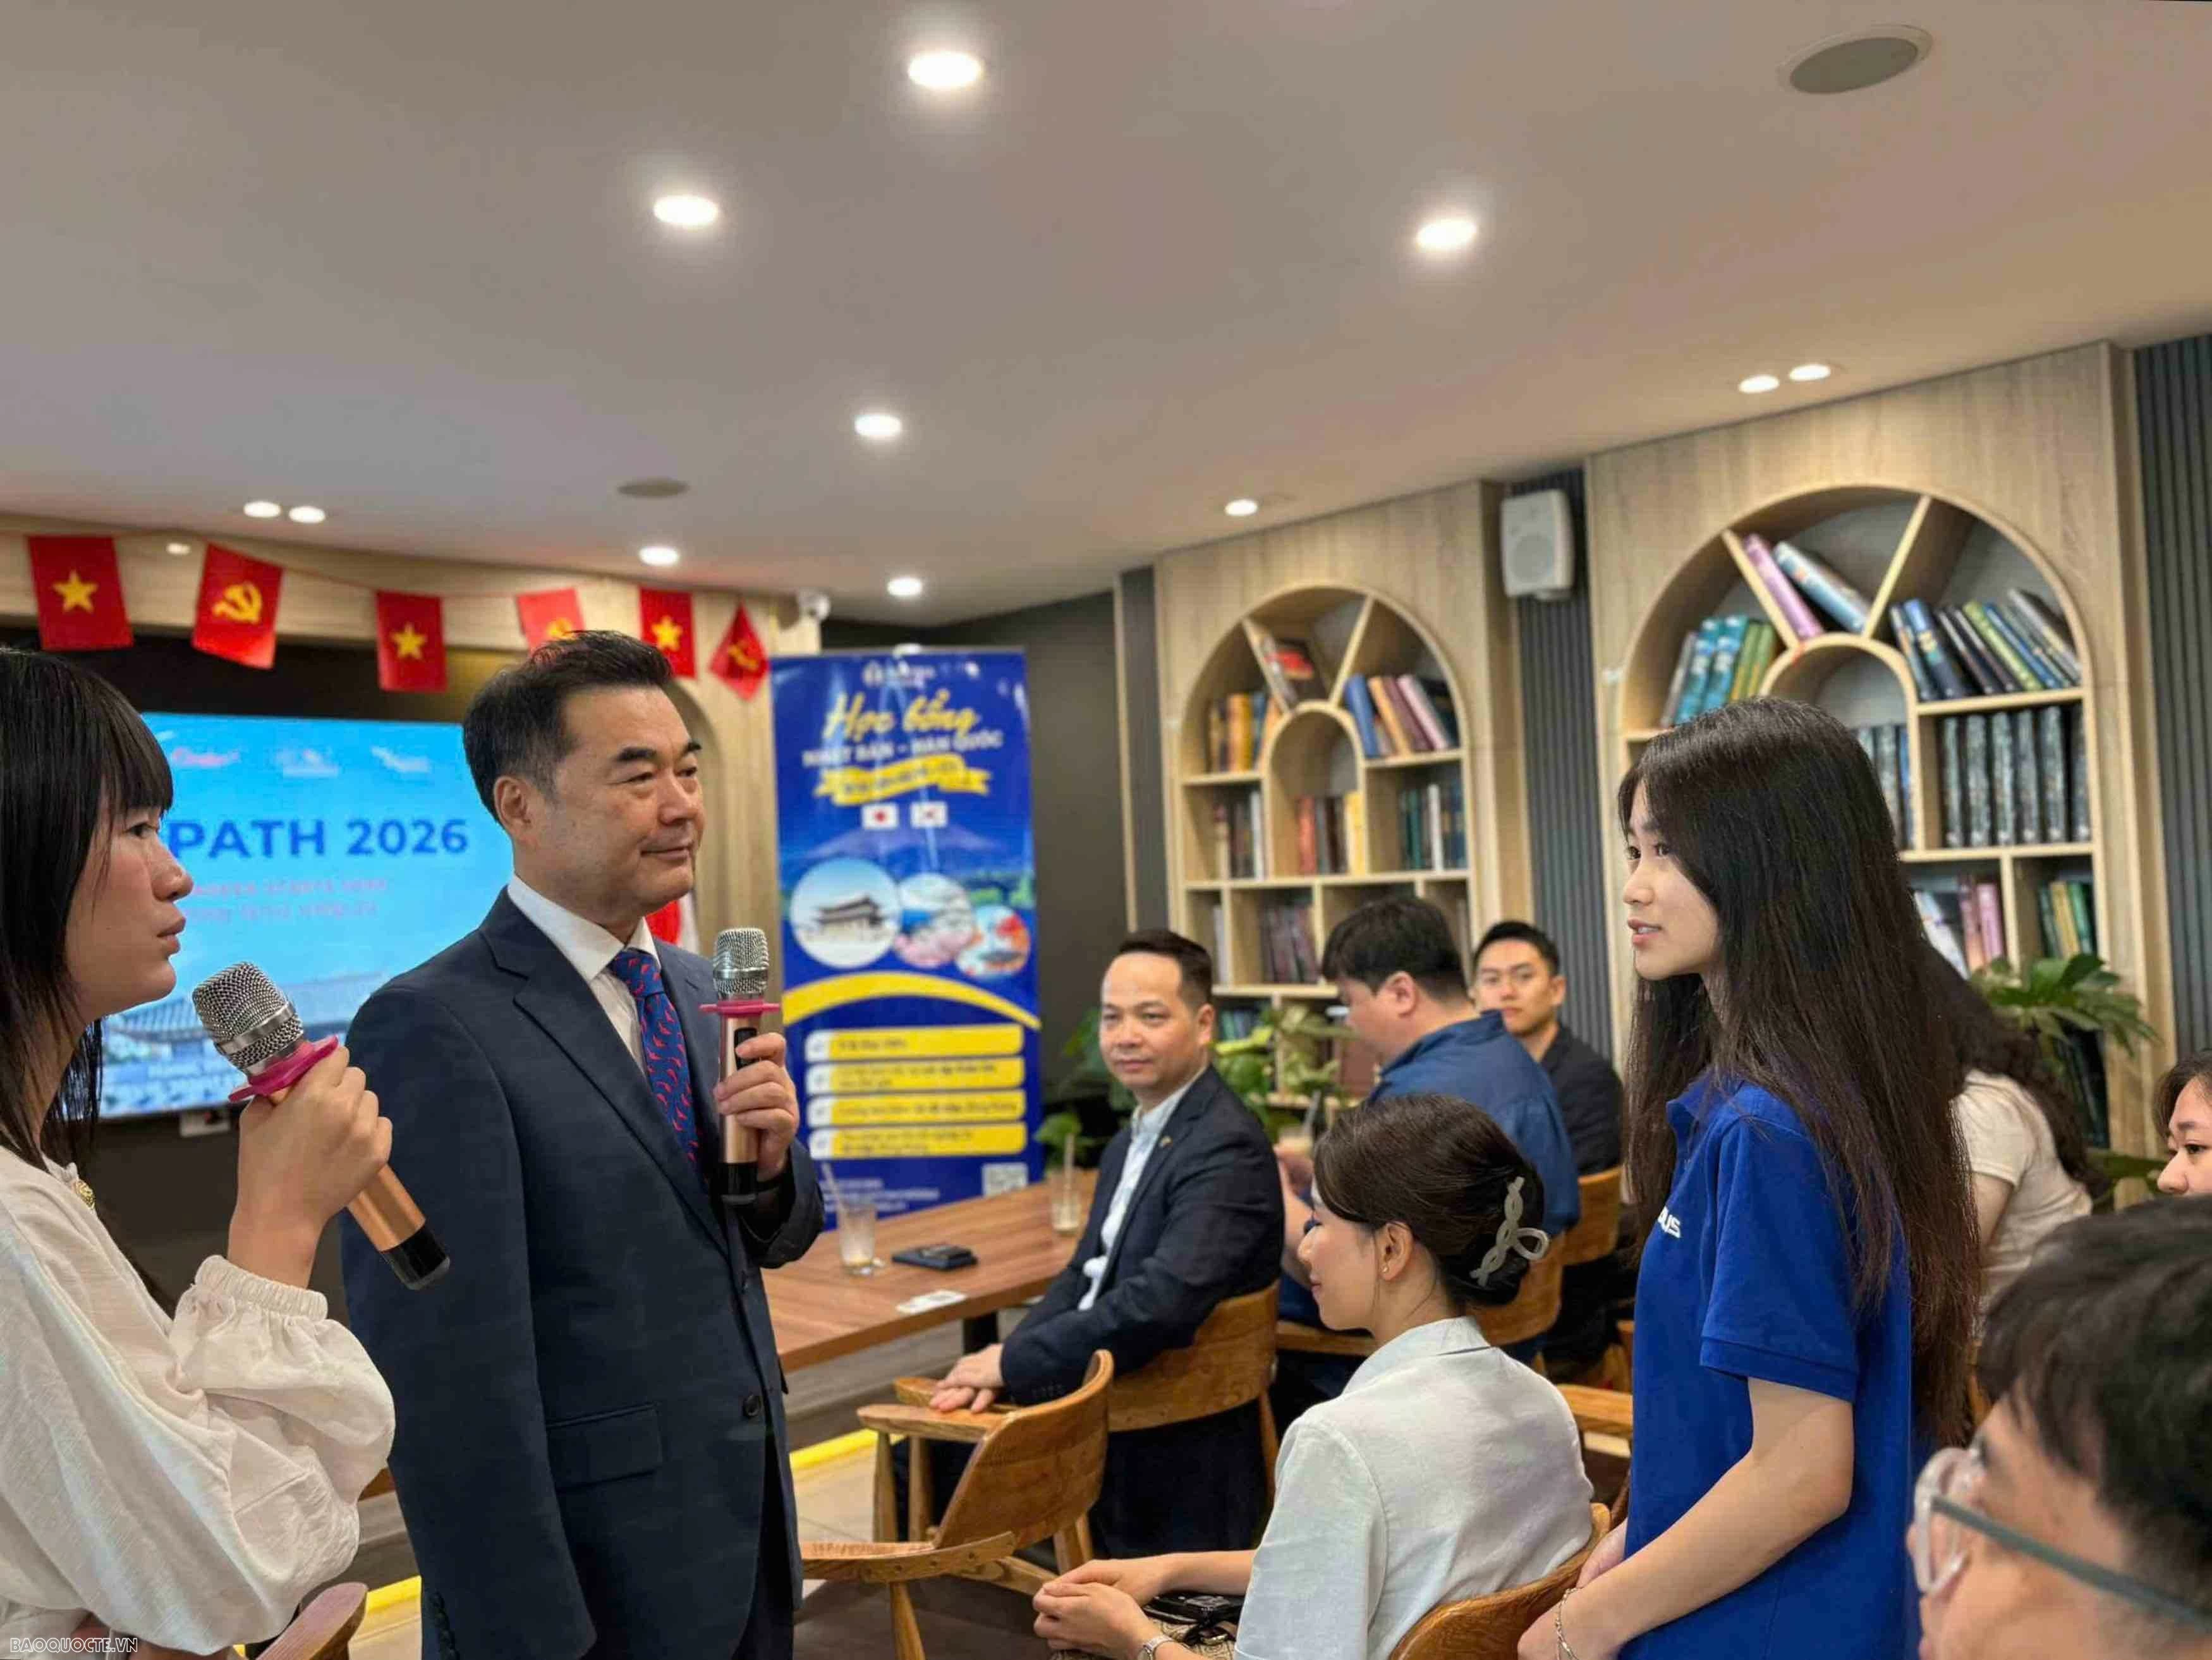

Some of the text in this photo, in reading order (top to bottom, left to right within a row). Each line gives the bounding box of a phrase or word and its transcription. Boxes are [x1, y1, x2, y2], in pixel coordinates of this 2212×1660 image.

[823, 688, 981, 742] Học bổng
[346, 818, 468, 857] 2026
